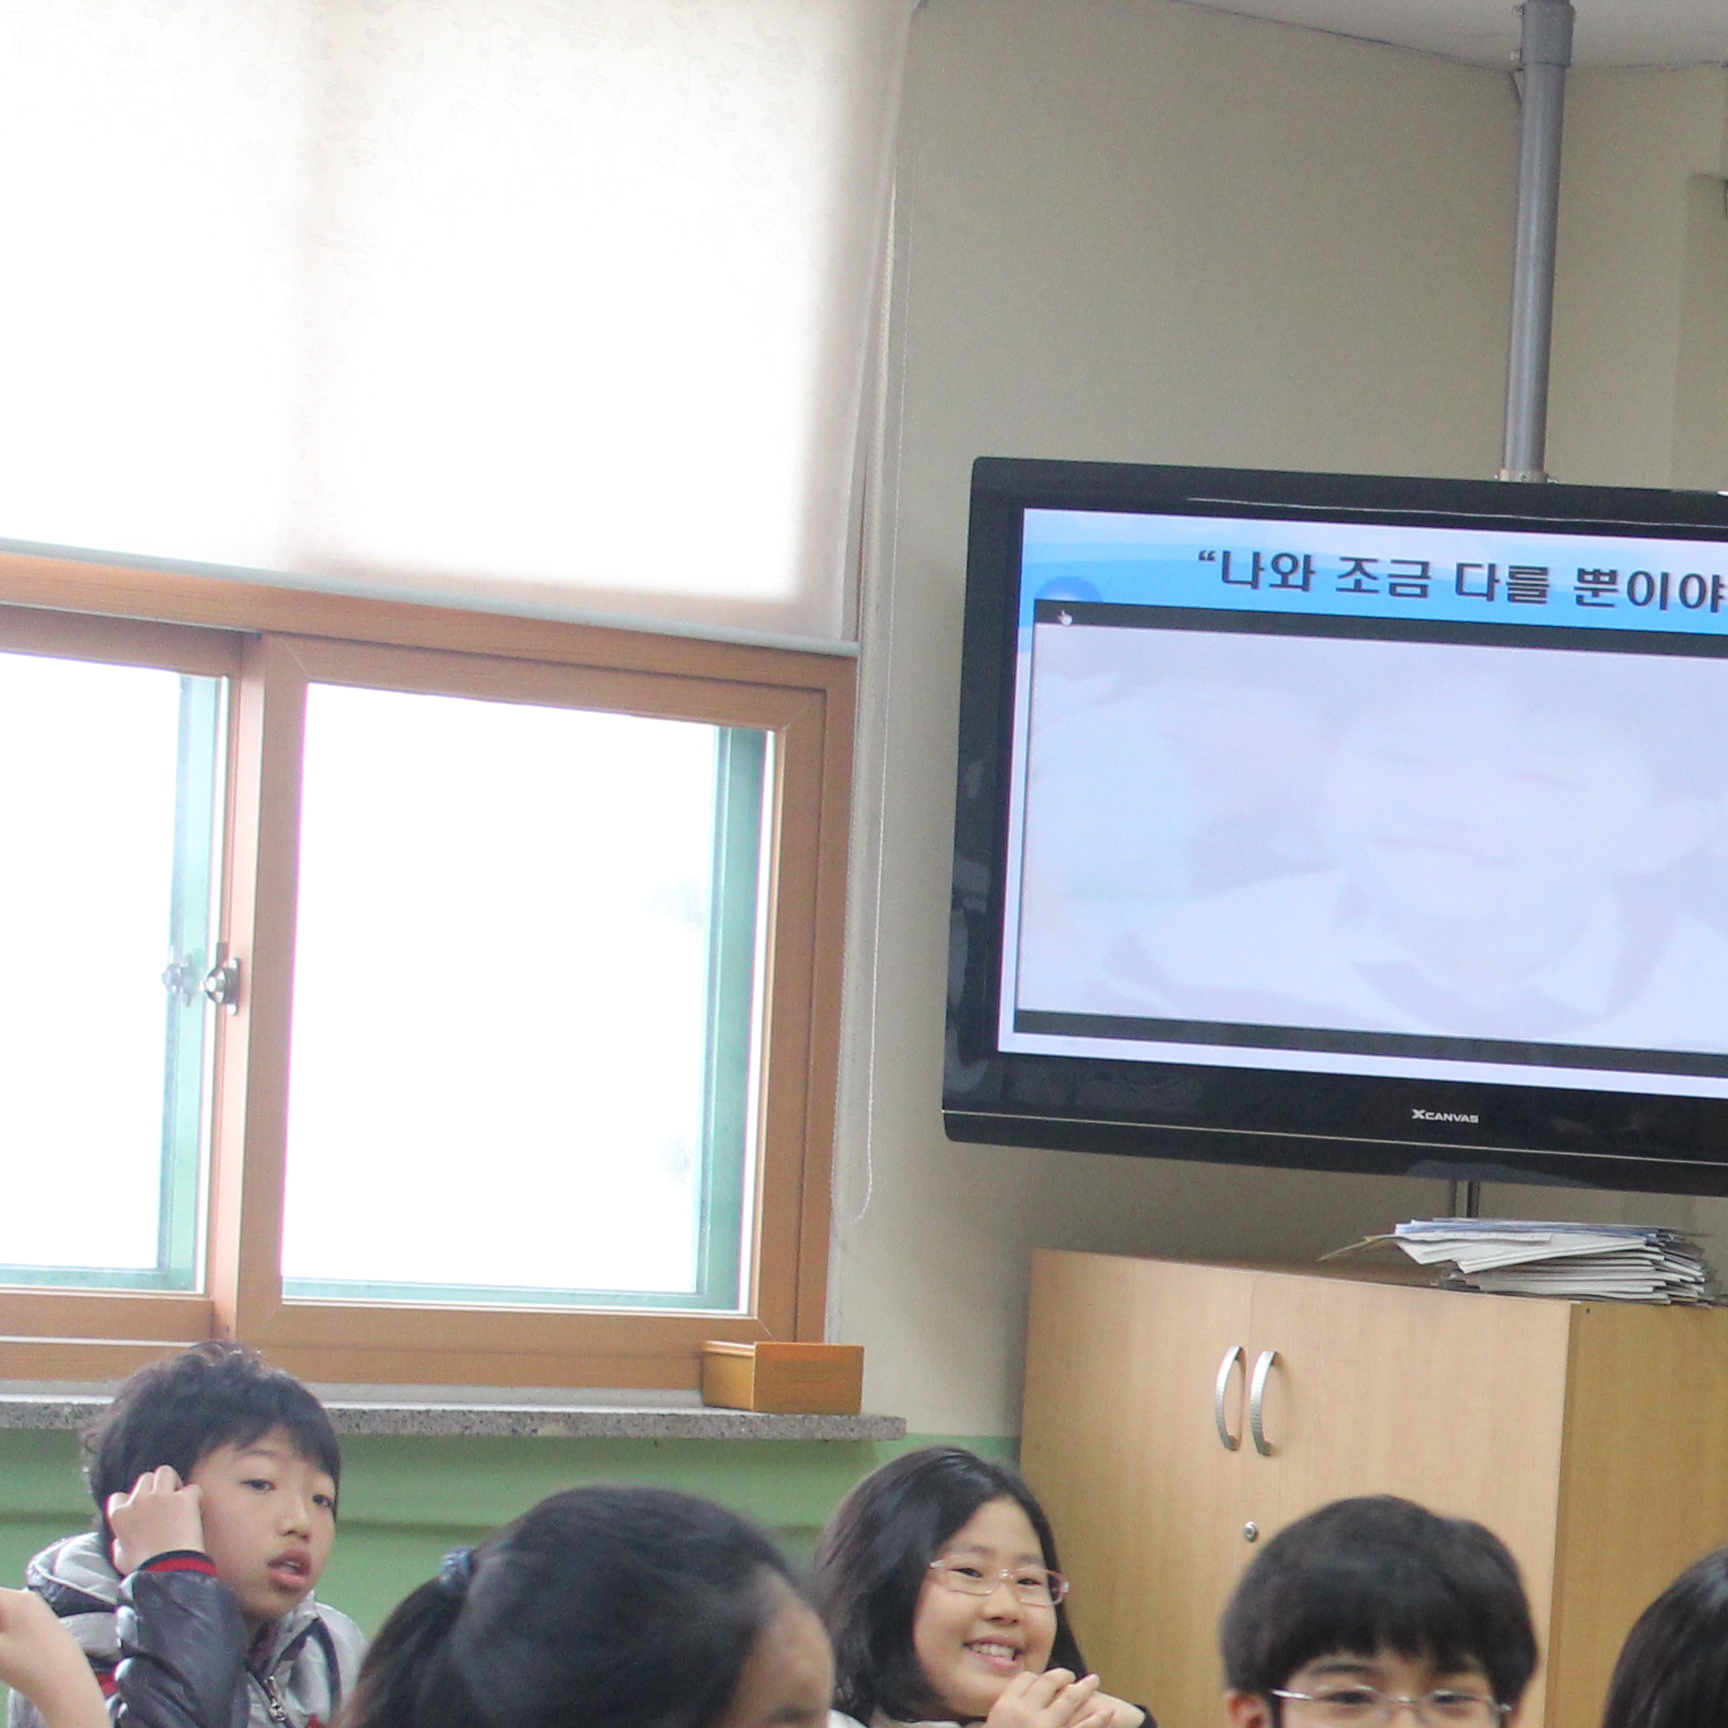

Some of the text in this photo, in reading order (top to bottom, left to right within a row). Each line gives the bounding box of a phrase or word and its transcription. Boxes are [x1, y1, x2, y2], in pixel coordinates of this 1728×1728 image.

[1336, 556, 1431, 599] 조금
[1455, 562, 1548, 605] 다를
[1411, 1109, 1479, 1124] XCANVAS
